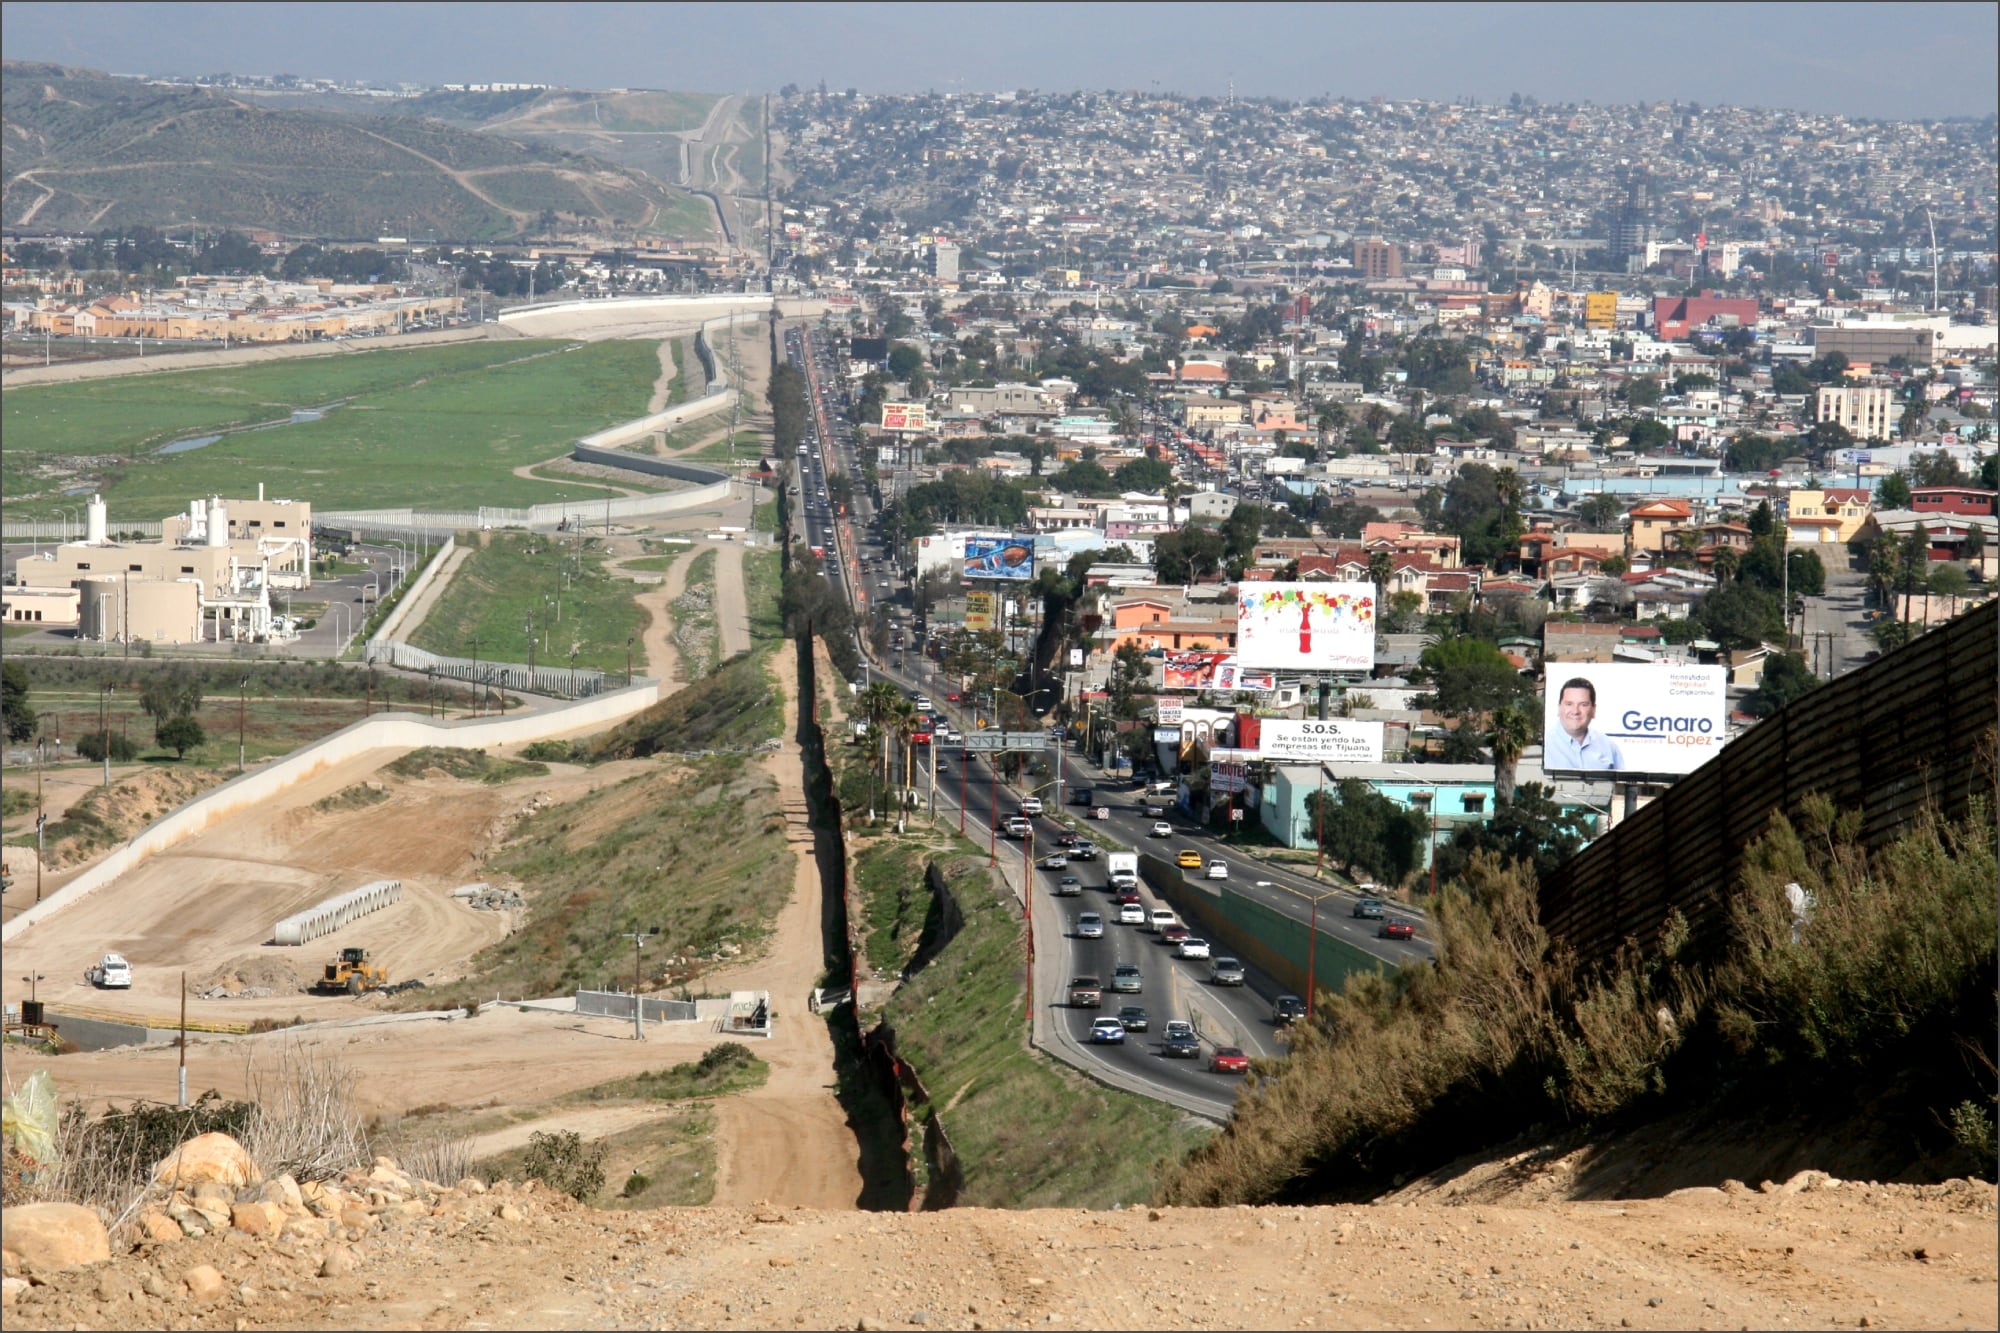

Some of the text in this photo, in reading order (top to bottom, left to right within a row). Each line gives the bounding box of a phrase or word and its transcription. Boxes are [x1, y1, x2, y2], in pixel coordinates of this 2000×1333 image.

[1622, 710, 1713, 733] Genaro
[1302, 724, 1342, 735] S.O.S.
[1320, 736, 1350, 745] yendo
[1351, 736, 1366, 744] las
[1667, 733, 1712, 748] López
[1271, 742, 1371, 753] empresas de Tijuana
